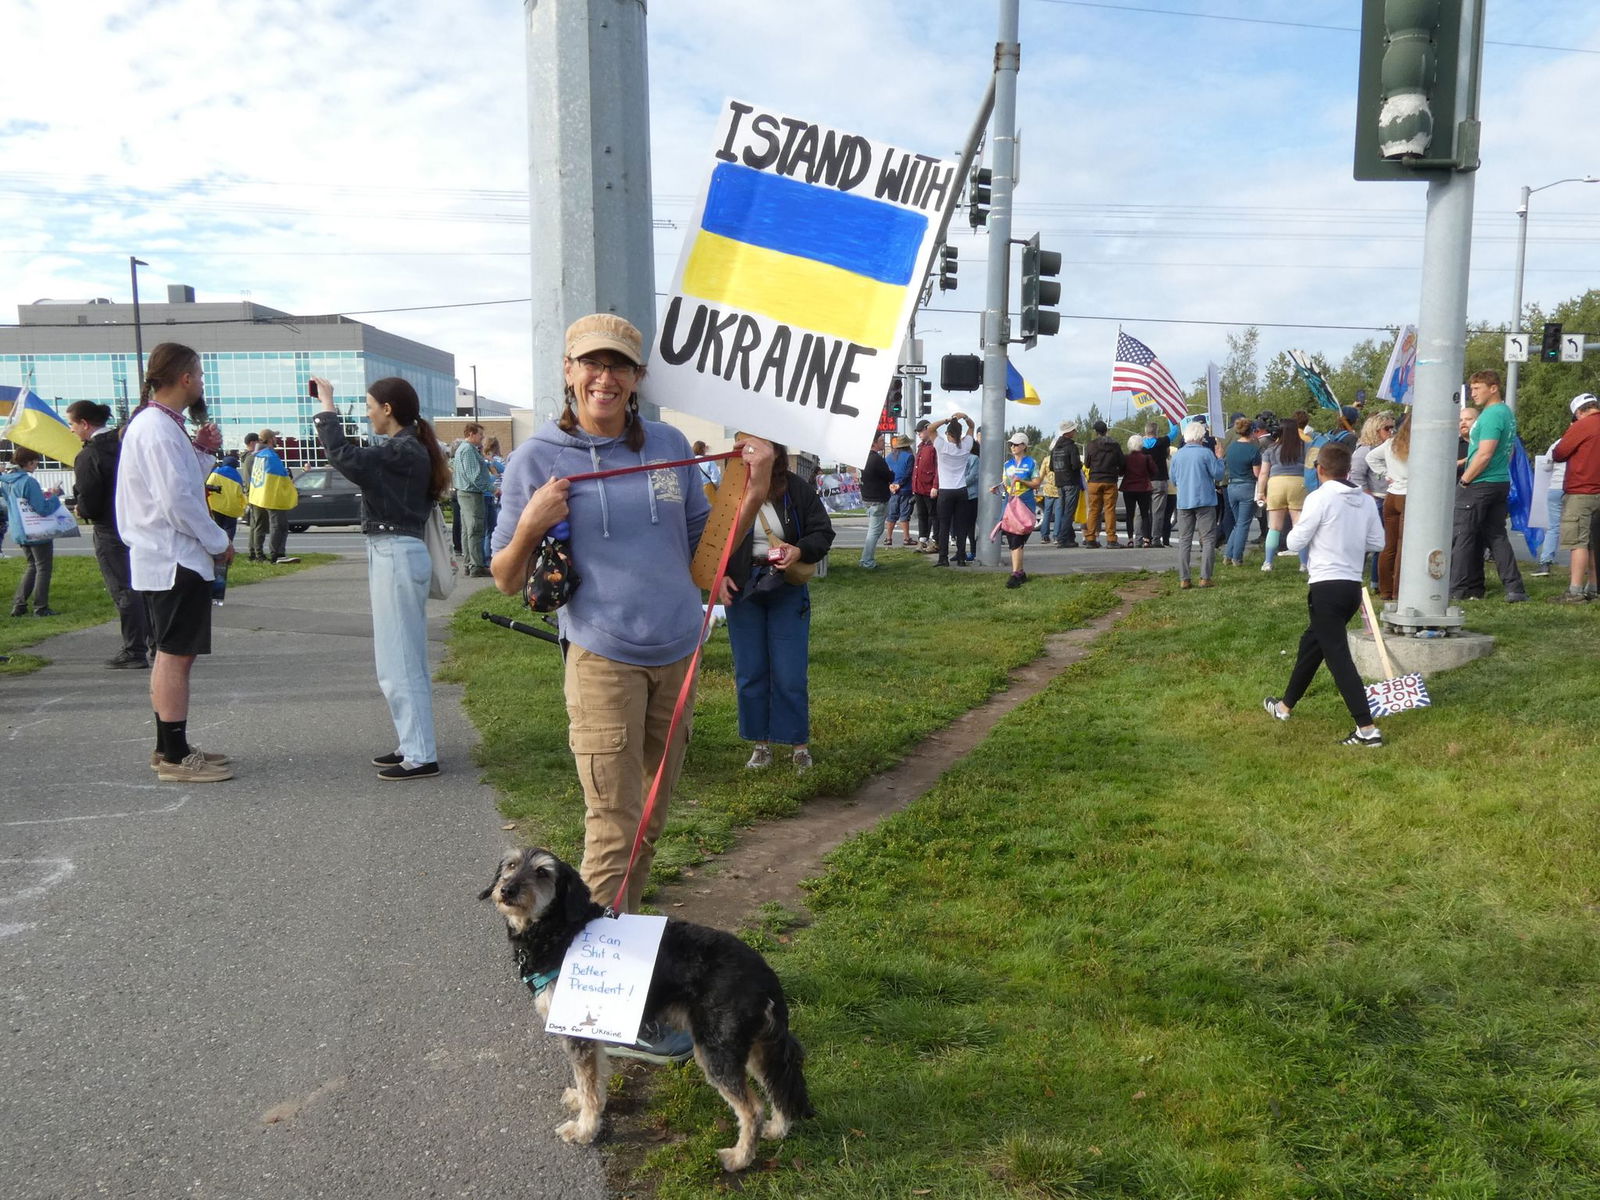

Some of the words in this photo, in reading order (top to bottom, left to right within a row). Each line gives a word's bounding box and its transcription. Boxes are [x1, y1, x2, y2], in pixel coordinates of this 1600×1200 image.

[715, 101, 753, 163] I
[742, 113, 872, 192] STAND
[875, 147, 955, 212] WITH
[659, 296, 877, 418] UKRAINE
[1367, 676, 1417, 698] OBEY
[1383, 688, 1418, 705] NOT
[1390, 699, 1413, 711] DO
[582, 932, 592, 942] I
[598, 934, 621, 946] Can
[581, 944, 605, 958] Shit
[612, 952, 620, 960] a
[572, 962, 607, 977] Better
[549, 1023, 566, 1032] Dogs
